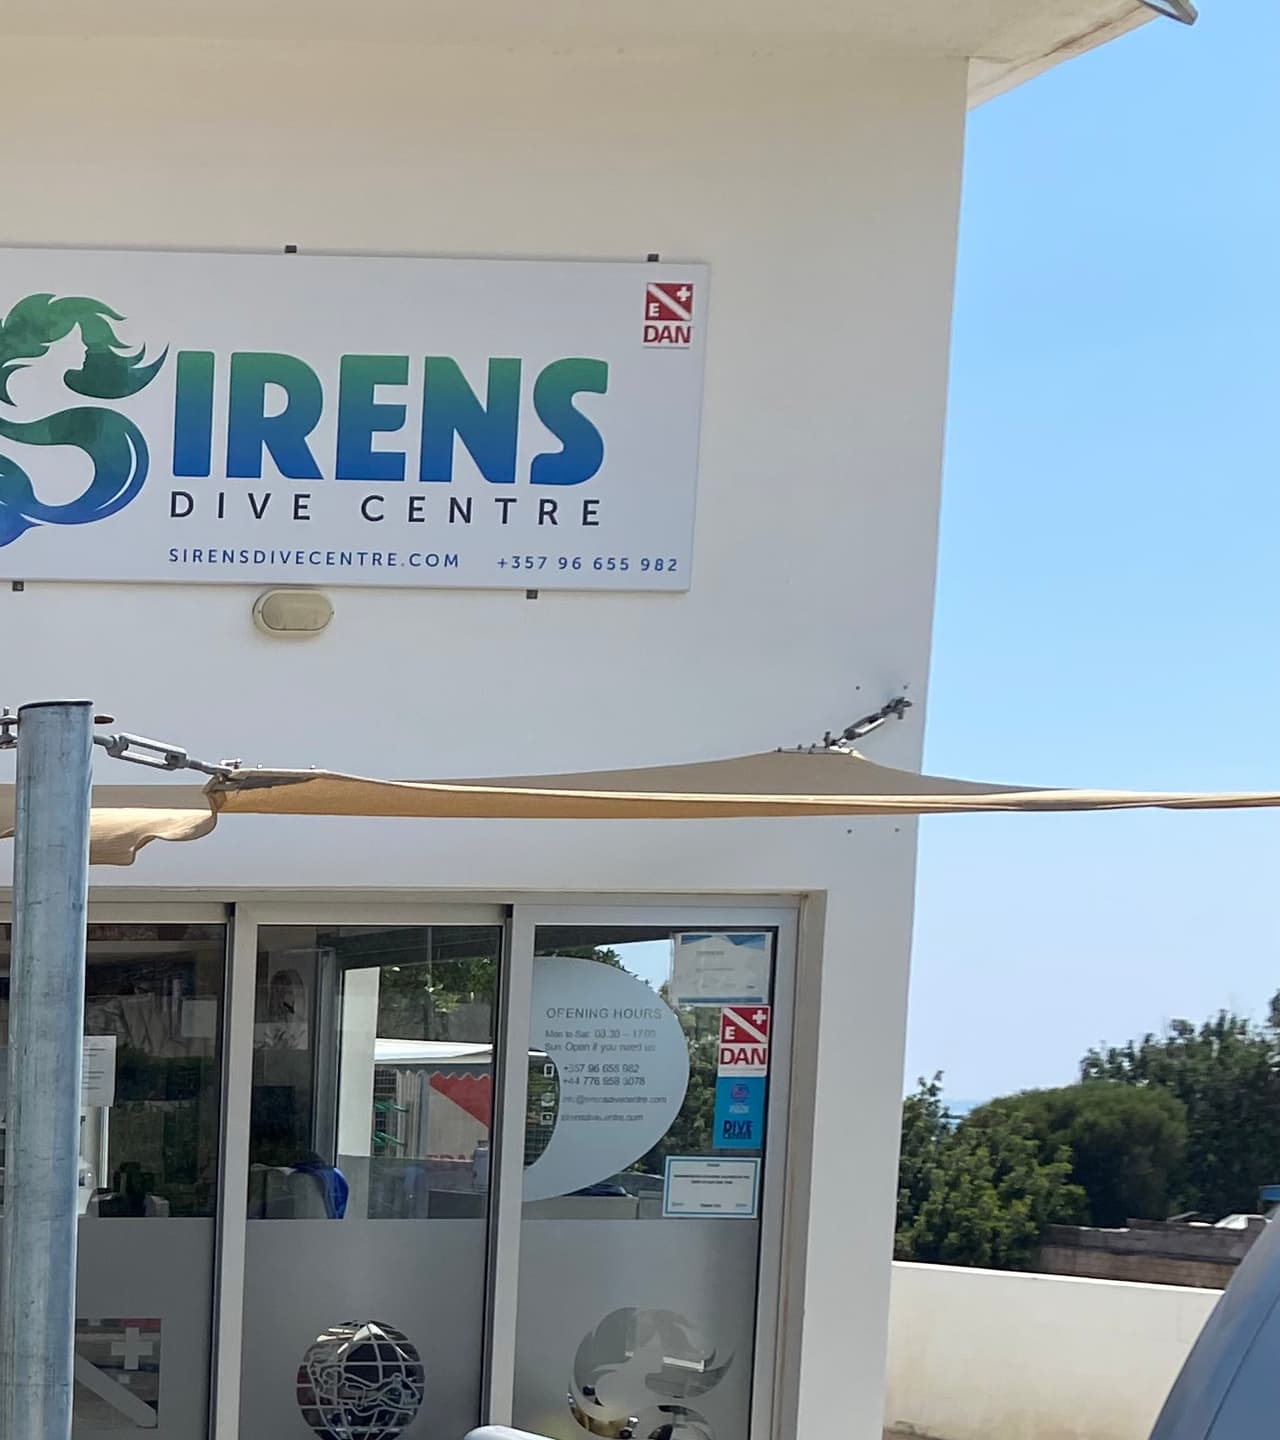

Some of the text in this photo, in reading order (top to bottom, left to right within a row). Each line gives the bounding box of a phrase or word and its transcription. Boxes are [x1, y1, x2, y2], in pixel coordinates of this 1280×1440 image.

[648, 303, 660, 317] E
[643, 324, 692, 344] DAN
[169, 491, 601, 527] DIVE CENTRE
[168, 548, 678, 573] SIRENSDIVECENTRE.COM +357 96 655 982
[546, 1007, 662, 1020] OPENING HOURS
[724, 1026, 735, 1040] E
[719, 1047, 767, 1066] DAN
